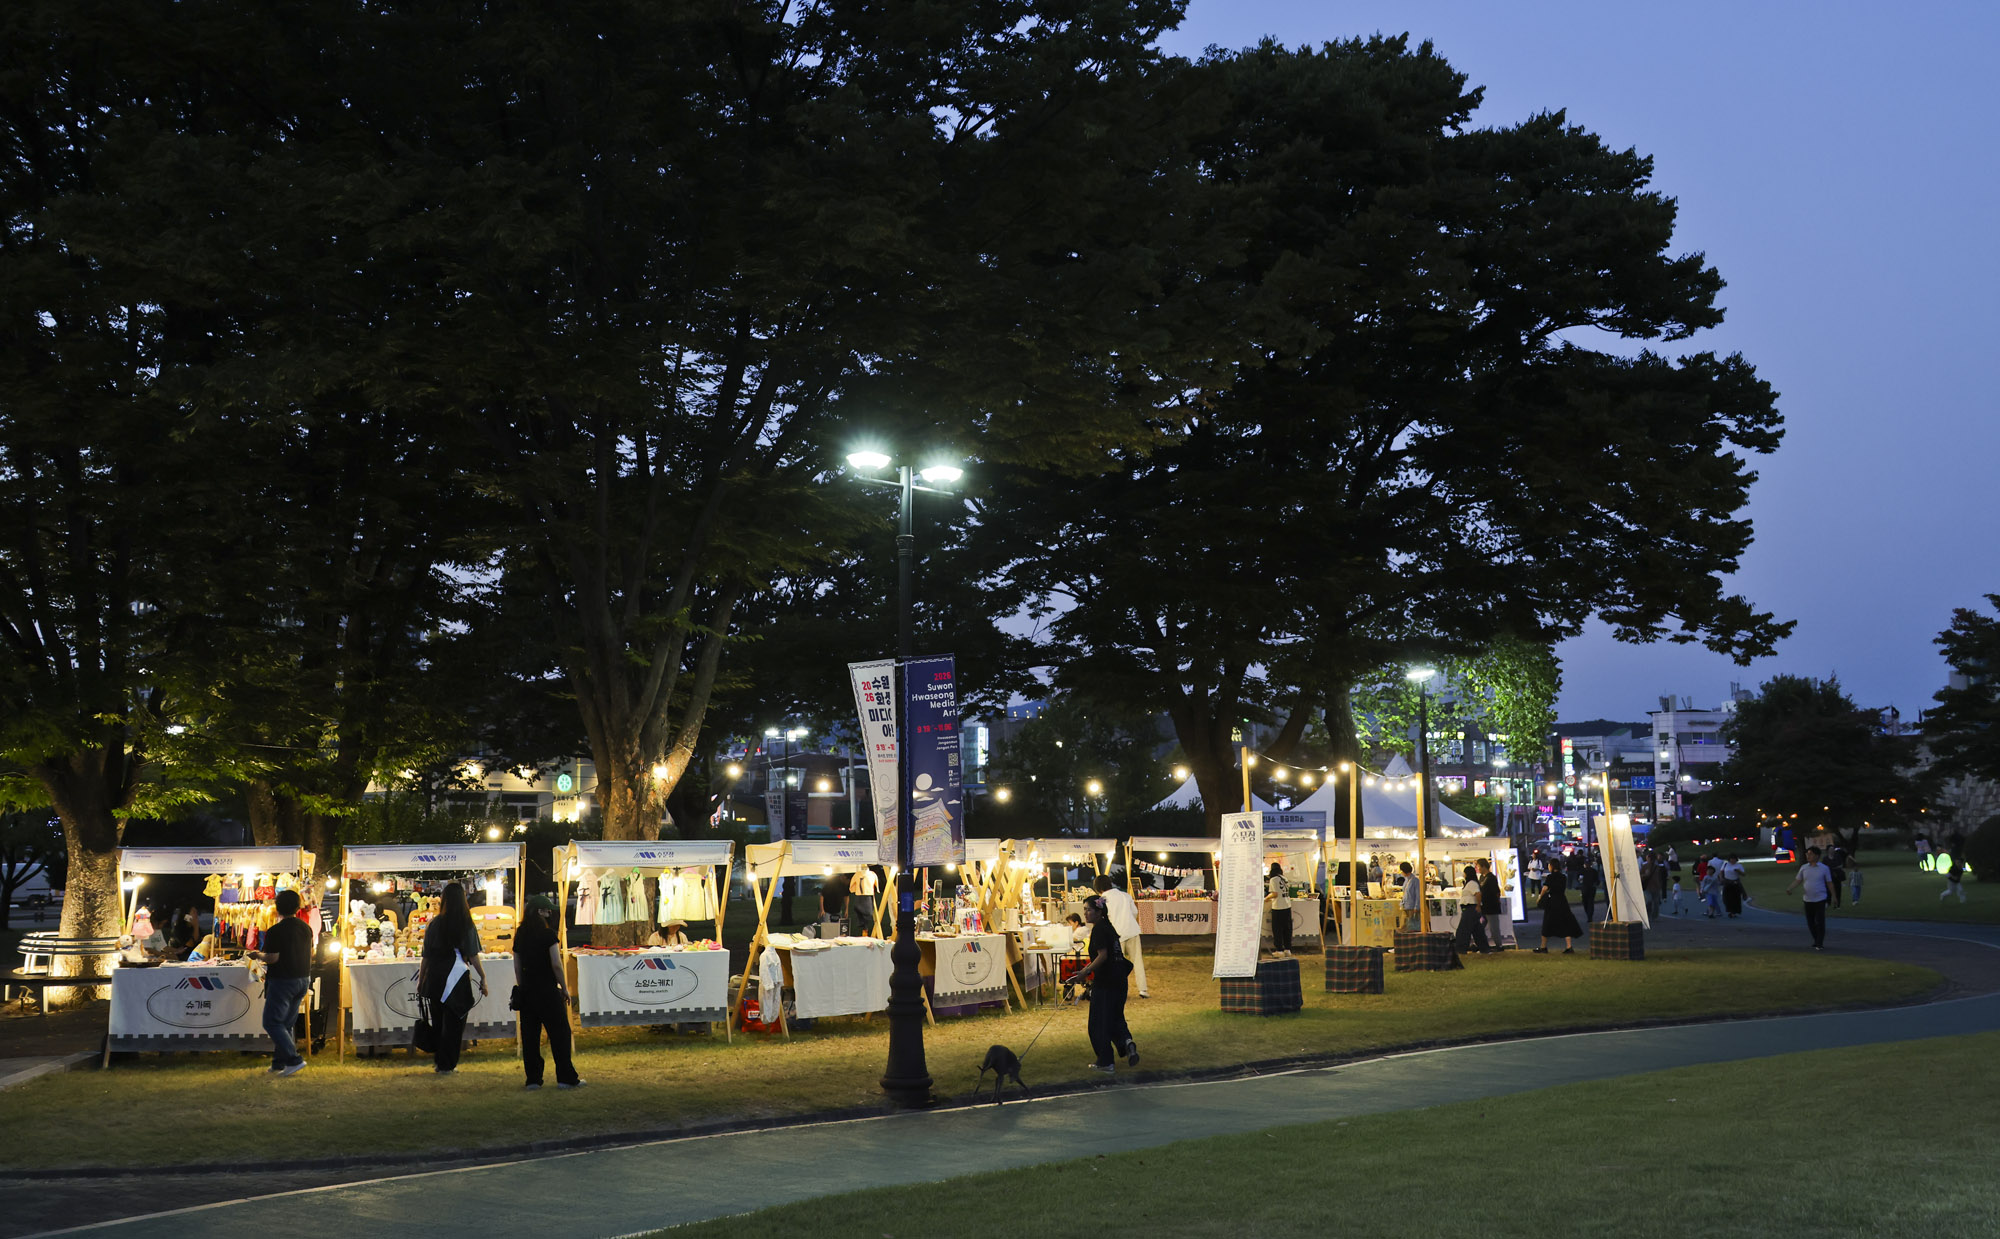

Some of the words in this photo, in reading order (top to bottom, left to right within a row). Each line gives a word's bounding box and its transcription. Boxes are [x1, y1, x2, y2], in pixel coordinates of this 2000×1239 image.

[934, 672, 952, 680] 2026
[861, 681, 872, 691] 20
[872, 675, 890, 690] 수원
[927, 683, 953, 691] Suwon
[864, 692, 875, 702] 26
[911, 691, 954, 701] Hwaseong
[930, 699, 955, 708] Media
[942, 709, 956, 717] Art
[1232, 830, 1256, 843] 수문장
